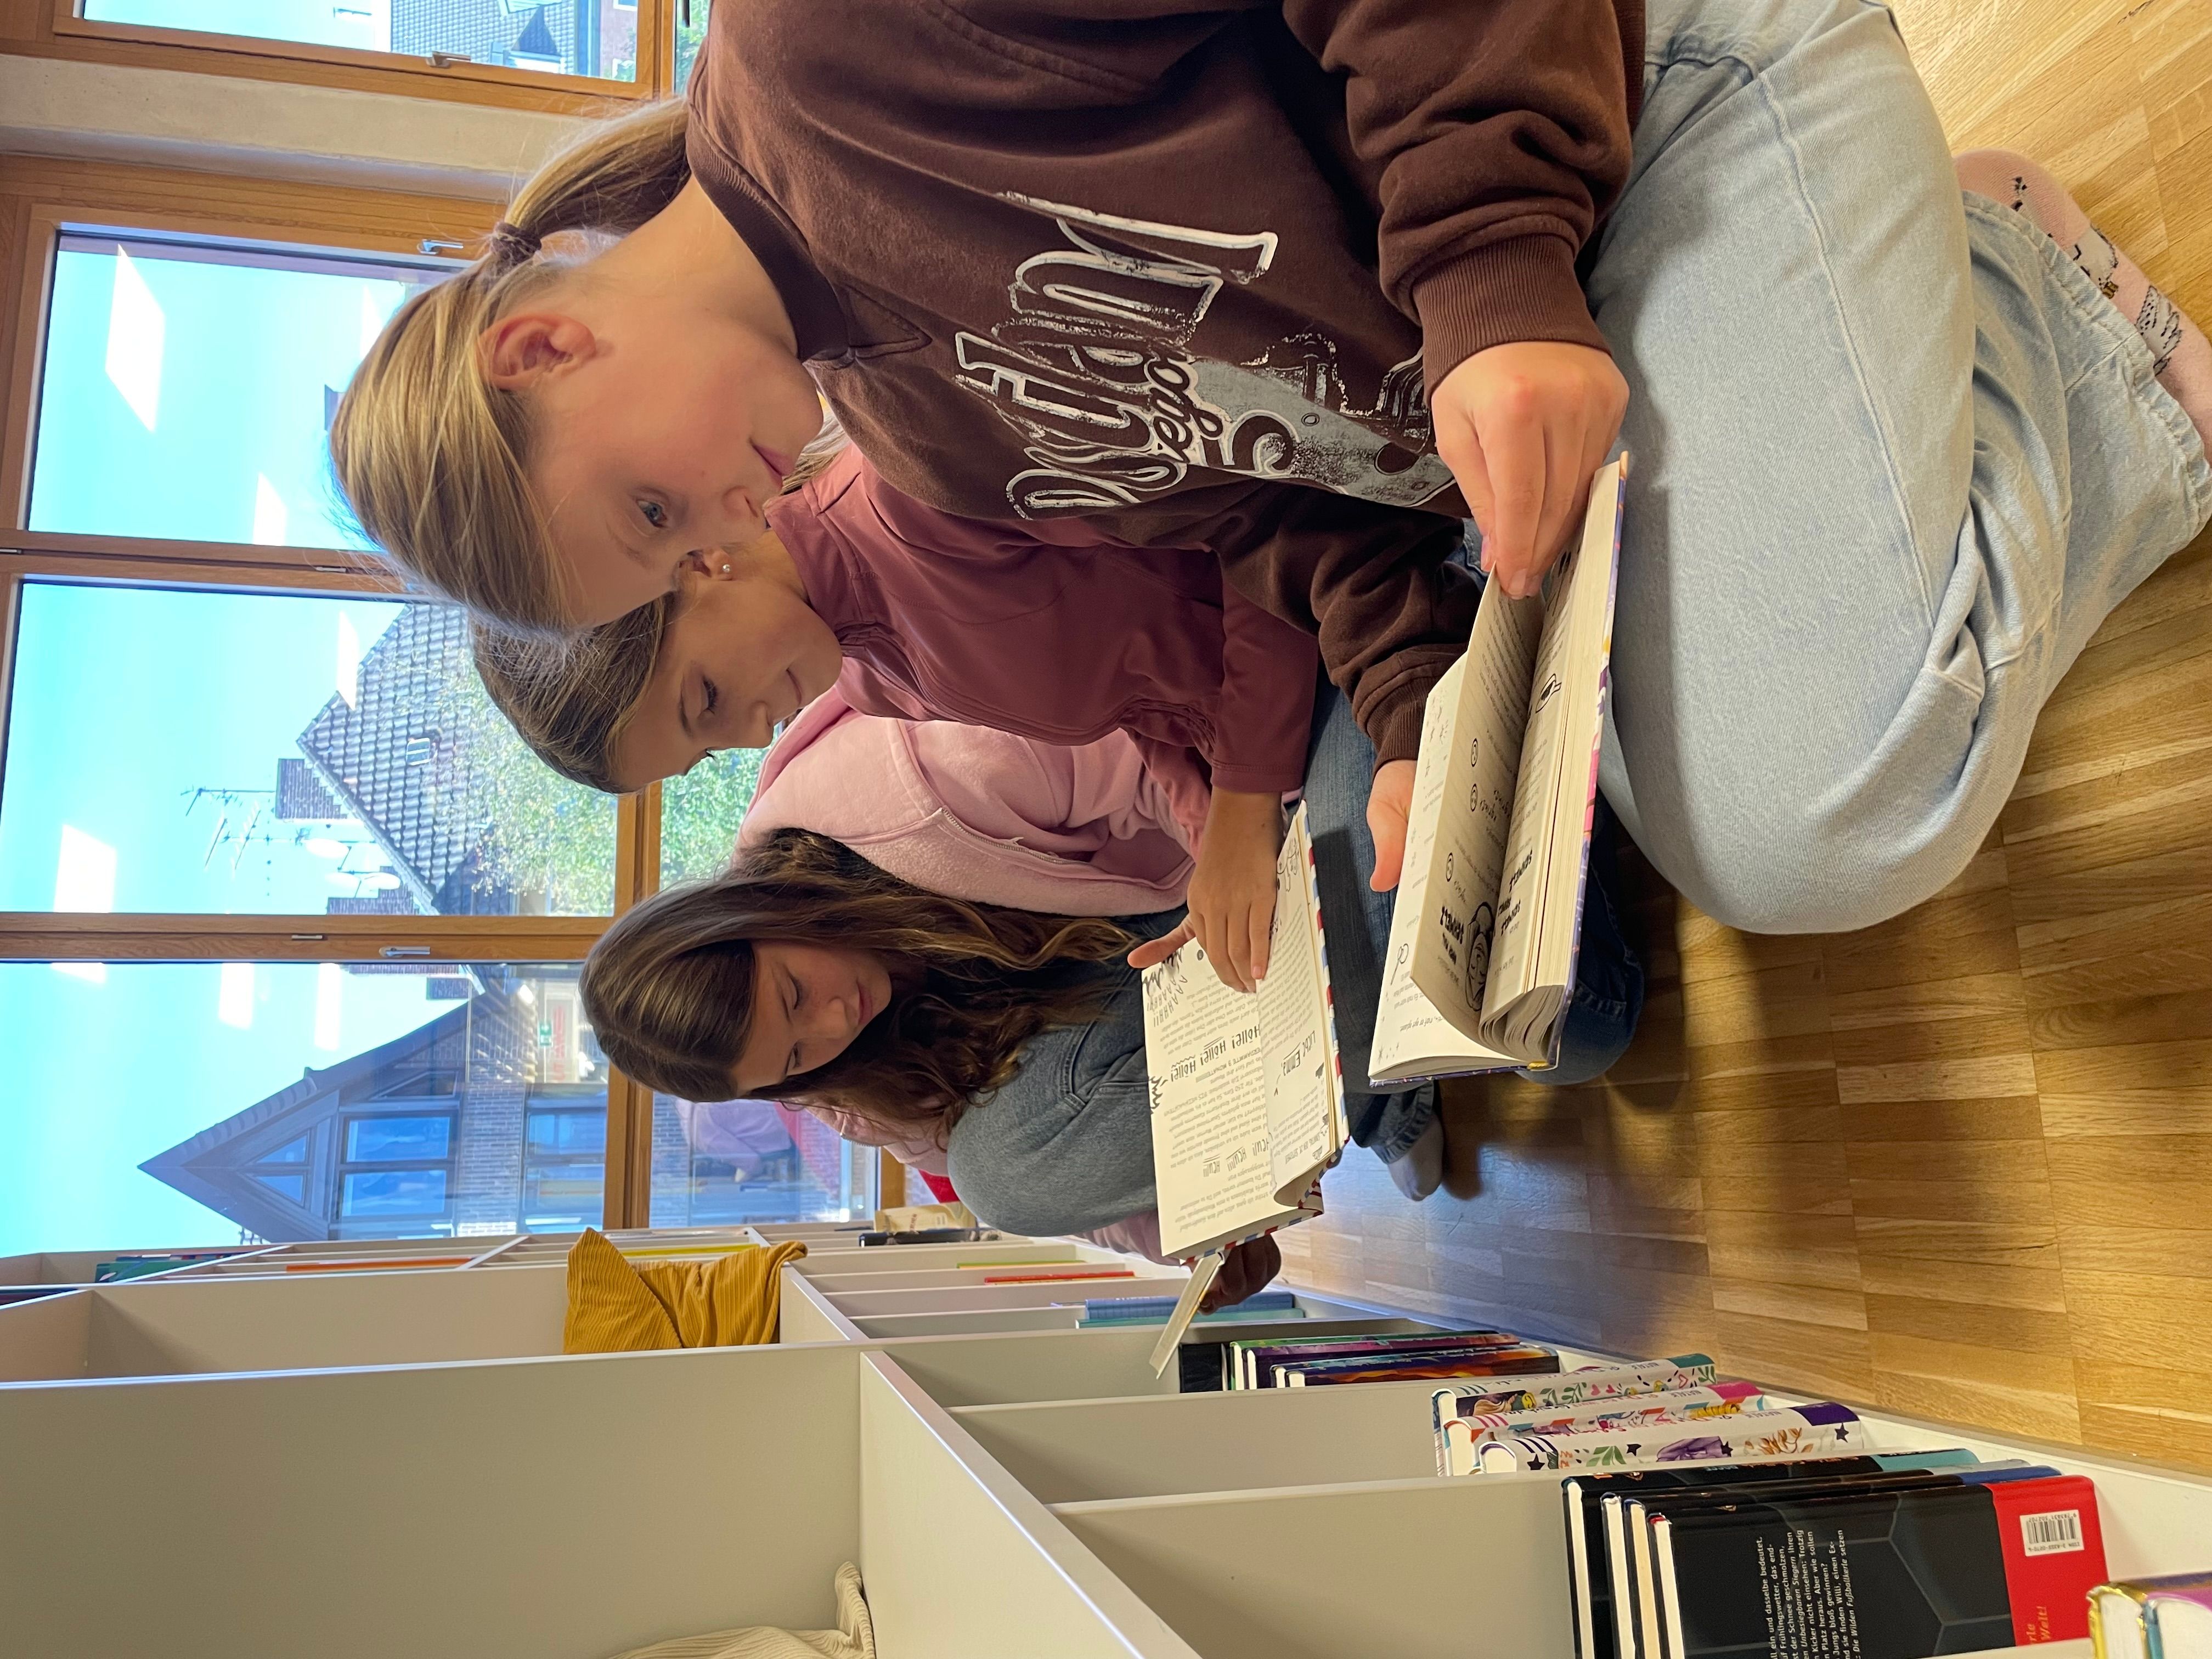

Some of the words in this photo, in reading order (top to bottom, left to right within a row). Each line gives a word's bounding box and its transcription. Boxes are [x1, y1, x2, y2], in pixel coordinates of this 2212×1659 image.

[1767, 1543, 1775, 1562] end-
[1796, 1529, 1807, 1557] Trotzig
[1807, 1531, 1816, 1555] sollen
[1837, 1529, 1846, 1555] setzen
[1756, 1536, 1767, 1575] bedeutet,
[1809, 1558, 1818, 1572] wie
[1831, 1556, 1839, 1579] einen
[1778, 1545, 1792, 1600] geschmolzen,
[1790, 1556, 1800, 1585] Siegern
[1801, 1560, 1812, 1600] einsehen:
[1839, 1558, 1854, 1606] Fußballkerle
[1761, 1578, 1772, 1613] dasselbe
[1821, 1562, 1834, 1606] gewinnen?
[1765, 1617, 1774, 1632] und
[1773, 1582, 1787, 1648] Frühlingswetter,
[1785, 1604, 1796, 1632] Schnee
[1795, 1588, 1808, 1646] Unbesiegbaren
[1806, 1602, 1815, 1623] nicht
[1816, 1597, 1826, 1626] heraus.
[1827, 1609, 1836, 1627] bloß
[1838, 1606, 1847, 1632] finden
[1848, 1609, 1858, 1635] Wilden
[1768, 1635, 1776, 1649] ein
[1810, 1627, 1819, 1651] Kicker
[1820, 1629, 1829, 1650] Platz
[1831, 1630, 1840, 1655] Jungs
[1852, 1638, 1860, 1651] Die
